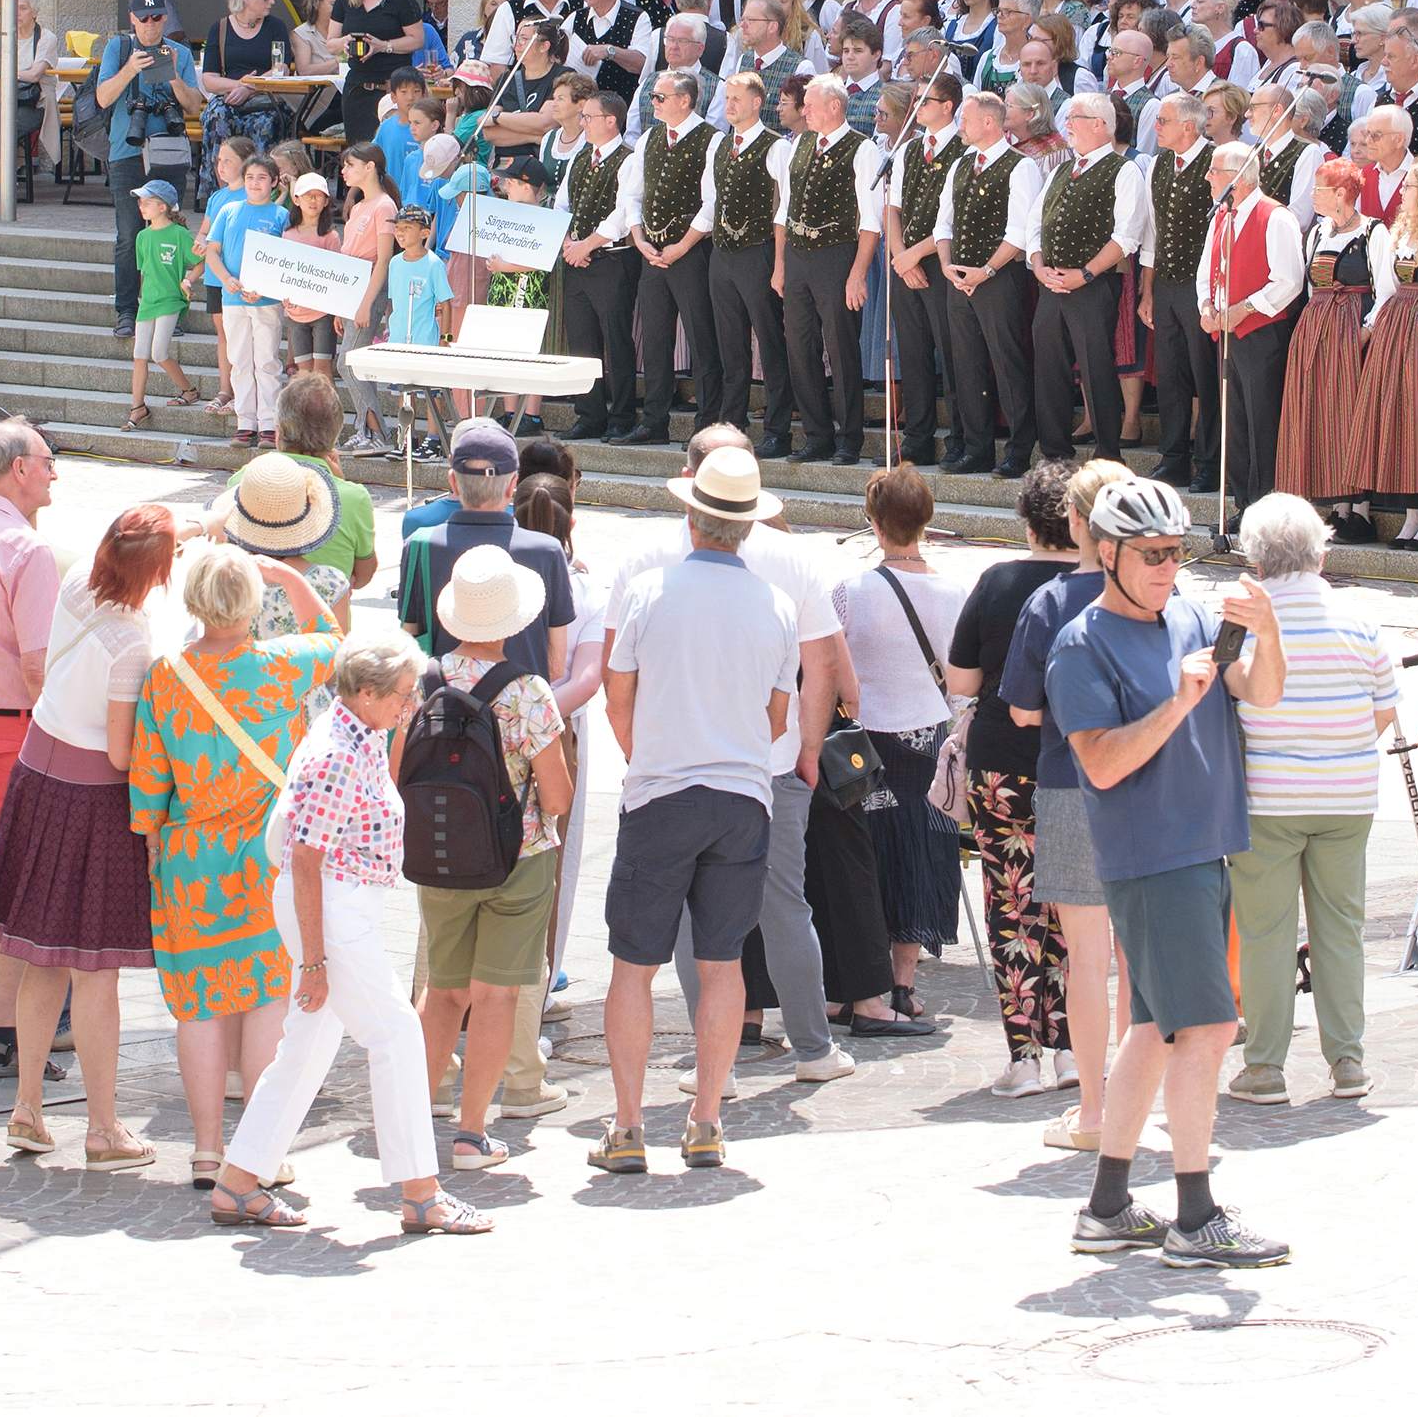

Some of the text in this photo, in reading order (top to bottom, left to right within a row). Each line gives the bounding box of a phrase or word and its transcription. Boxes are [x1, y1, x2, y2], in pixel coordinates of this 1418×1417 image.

[485, 214, 536, 235] Sängerrunde
[254, 250, 359, 286] Chor der Volksschule 7
[280, 273, 328, 294] Landskron
